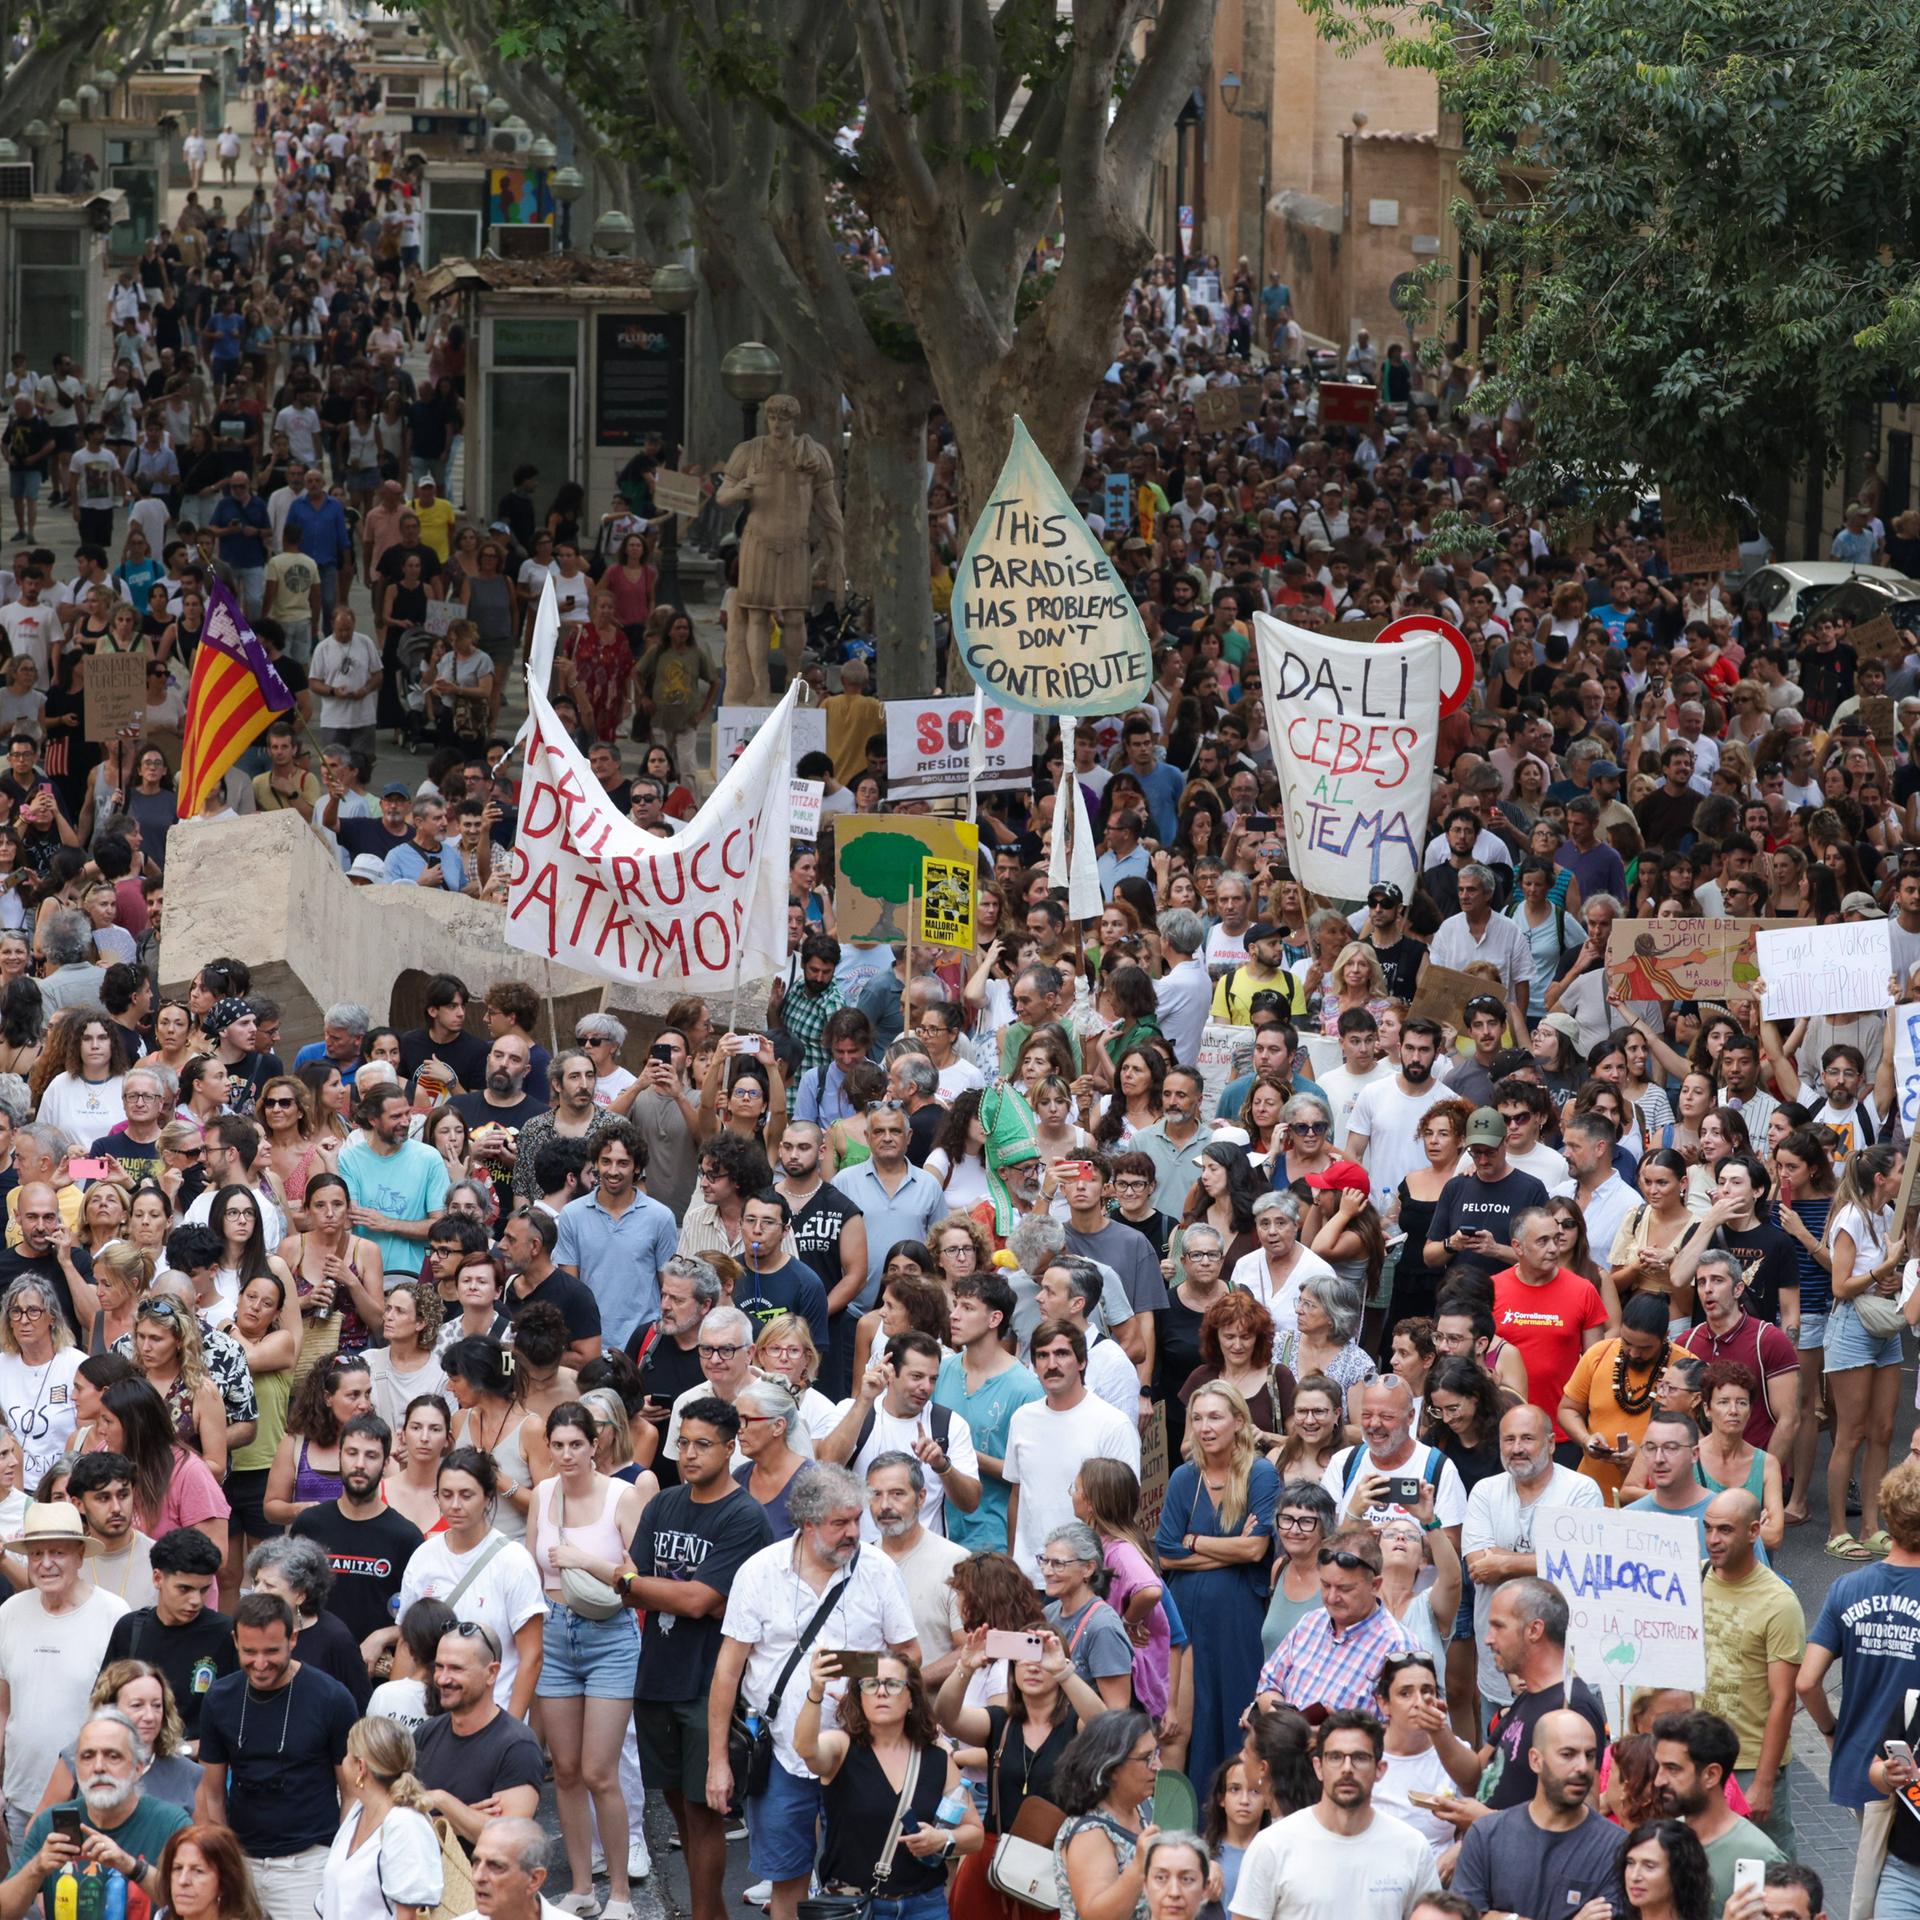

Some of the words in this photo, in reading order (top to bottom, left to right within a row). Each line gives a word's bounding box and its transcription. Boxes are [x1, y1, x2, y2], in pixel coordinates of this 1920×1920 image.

[964, 598, 1018, 630] HAS
[1027, 593, 1129, 622] PROBLEMS
[1017, 624, 1098, 650] DON'T
[916, 706, 1005, 756] SOS
[1287, 717, 1418, 789] CEBES
[1313, 774, 1354, 805] AL
[925, 919, 959, 932] MALLORCA
[925, 928, 933, 938] AL
[1648, 919, 1663, 930] EL
[1669, 918, 1706, 932] JORN
[1714, 918, 1742, 931] DEL
[1663, 933, 1712, 947] JUDICI
[1770, 932, 1816, 968] Engel
[1685, 970, 1700, 979] HA
[1462, 1203, 1511, 1214] PELOTON
[8, 1404, 49, 1440] SOS
[1545, 1549, 1687, 1606] MALLORCA
[1603, 1613, 1620, 1634] LA
[1840, 1598, 1872, 1628] DEUS
[1871, 1595, 1889, 1613] EX
[1855, 1621, 1920, 1644] MOTORCYCLES
[1887, 1639, 1915, 1653] SERVICE
